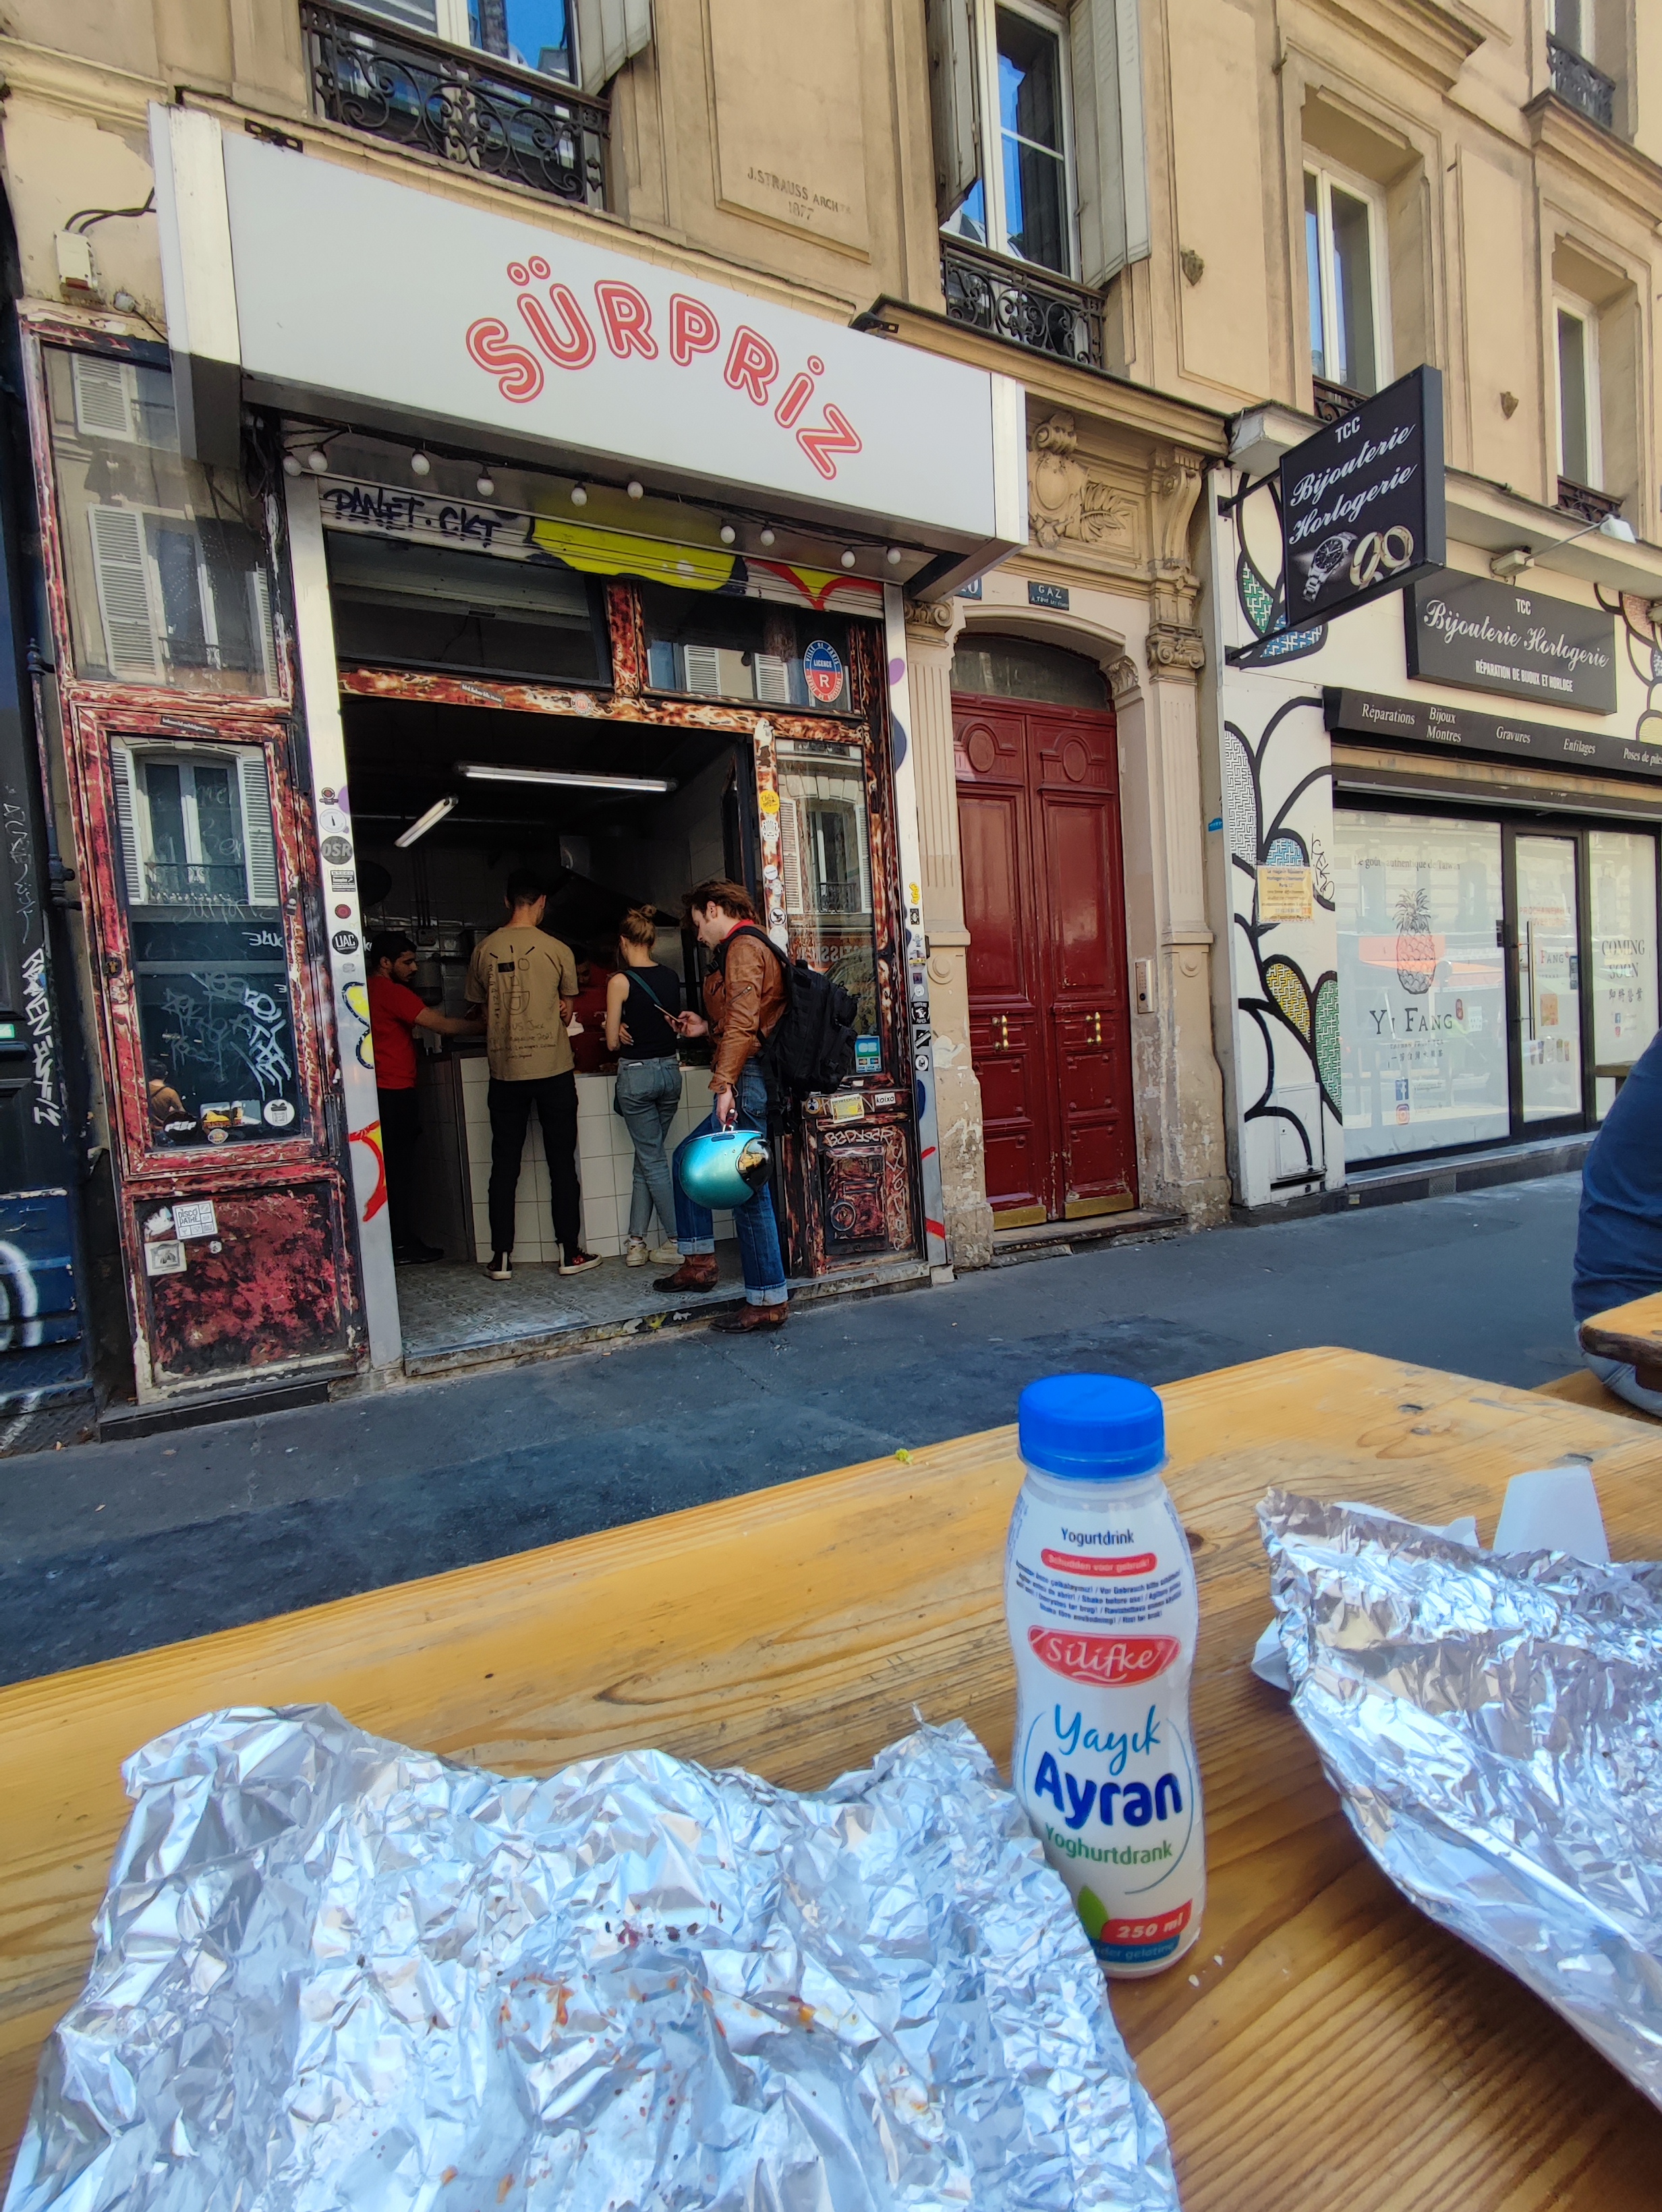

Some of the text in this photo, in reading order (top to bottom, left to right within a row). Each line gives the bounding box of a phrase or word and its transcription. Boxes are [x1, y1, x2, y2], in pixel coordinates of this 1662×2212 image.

[1334, 415, 1360, 444] TCC
[1290, 424, 1416, 506] Bijouterie
[1289, 463, 1418, 545] Horlogerie
[1039, 585, 1062, 599] GAZ
[1516, 598, 1531, 616] TCC
[1423, 600, 1609, 672] Bijouterie Horlogerie
[813, 660, 832, 668] LICENCE
[1475, 659, 1511, 680] RÉPARATION
[1512, 668, 1520, 682] DE
[1541, 674, 1549, 687] ET
[819, 674, 830, 689] R
[1362, 703, 1415, 725] Réparations
[1429, 707, 1456, 725] Bijoux
[1427, 725, 1462, 743] Montres
[1496, 726, 1531, 744] Gravures
[1564, 738, 1596, 755] Enfilages
[1623, 747, 1640, 761] Poses
[1641, 751, 1650, 763] de
[322, 843, 352, 857] DSR
[1386, 858, 1426, 871] authentique
[1541, 949, 1564, 964] FANG
[1602, 939, 1645, 956] COMING
[1609, 962, 1639, 979] SOON
[876, 1095, 894, 1103] kaixo
[178, 1208, 198, 1218] DISCO
[1061, 1527, 1135, 1547] Yogurtdrink
[1048, 1637, 1161, 1678] Silifke
[1054, 1704, 1161, 1776] Yayık
[1034, 1751, 1183, 1830] Ayran
[1044, 1822, 1173, 1865] Yoghurtdrank
[1116, 1912, 1184, 1939] 250 ml
